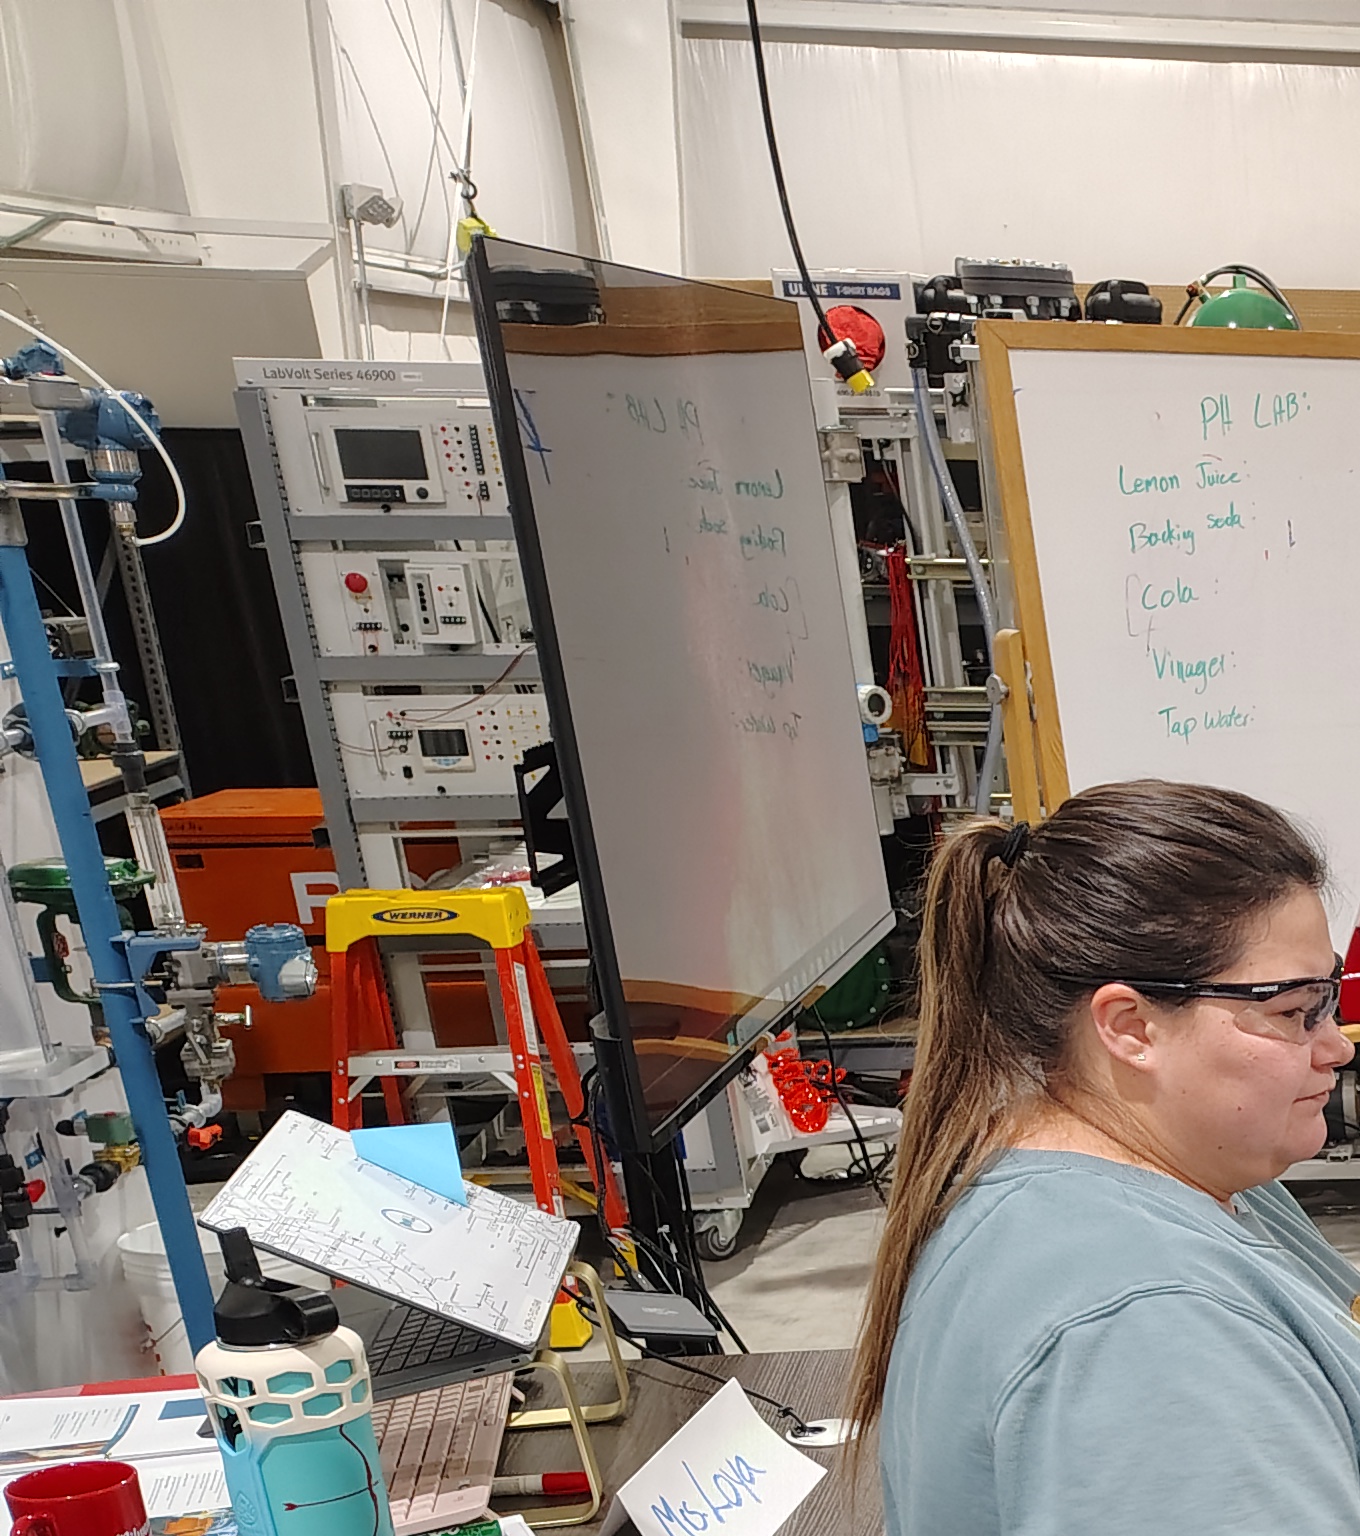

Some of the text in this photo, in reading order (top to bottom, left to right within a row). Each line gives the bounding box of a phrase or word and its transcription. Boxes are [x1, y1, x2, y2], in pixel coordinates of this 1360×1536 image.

[787, 282, 829, 296] ULNE
[262, 367, 396, 382] LabVolt Series 46900
[1200, 393, 1233, 441] PH
[1119, 465, 1180, 495] Lemon
[1158, 706, 1198, 742] Tap
[389, 910, 443, 921] WERNER
